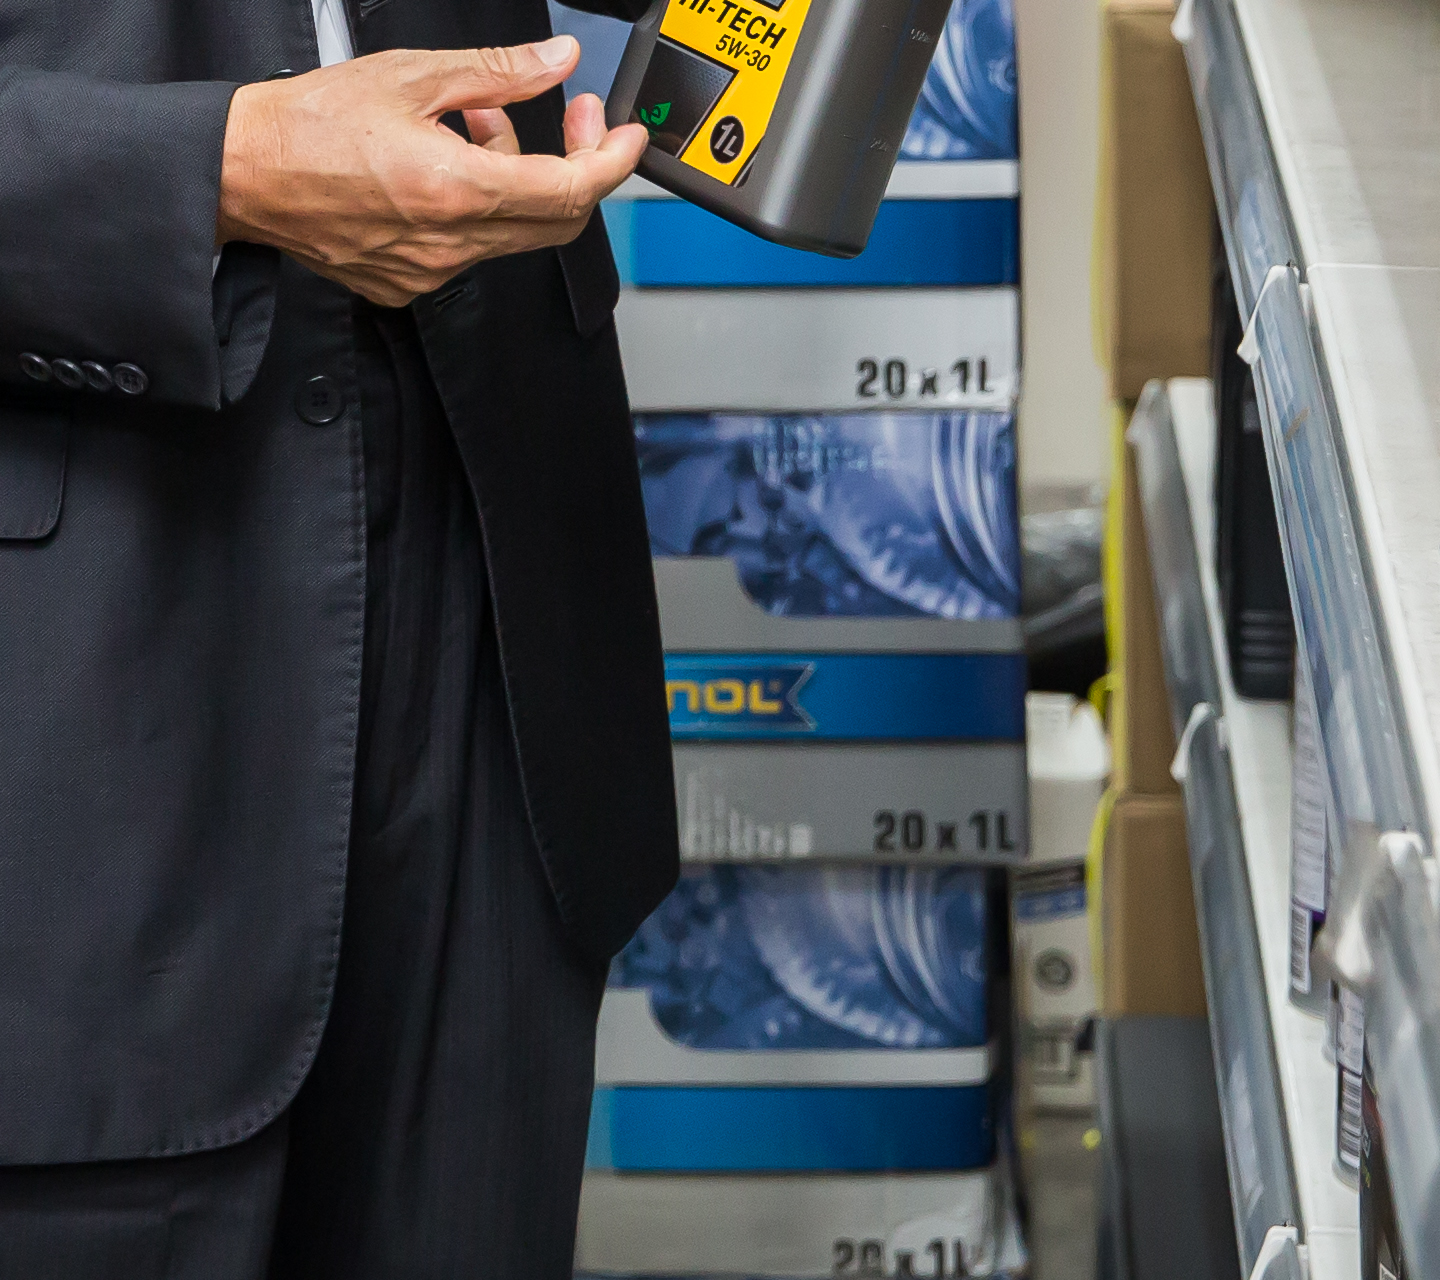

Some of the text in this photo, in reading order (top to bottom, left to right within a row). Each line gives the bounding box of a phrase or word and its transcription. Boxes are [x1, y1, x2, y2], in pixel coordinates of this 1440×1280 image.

[715, 34, 771, 72] 5W-30
[714, 122, 736, 157] 1L
[856, 356, 907, 400] 20
[951, 356, 995, 394] 1L
[873, 808, 926, 853] 20
[970, 808, 1017, 852] 1L
